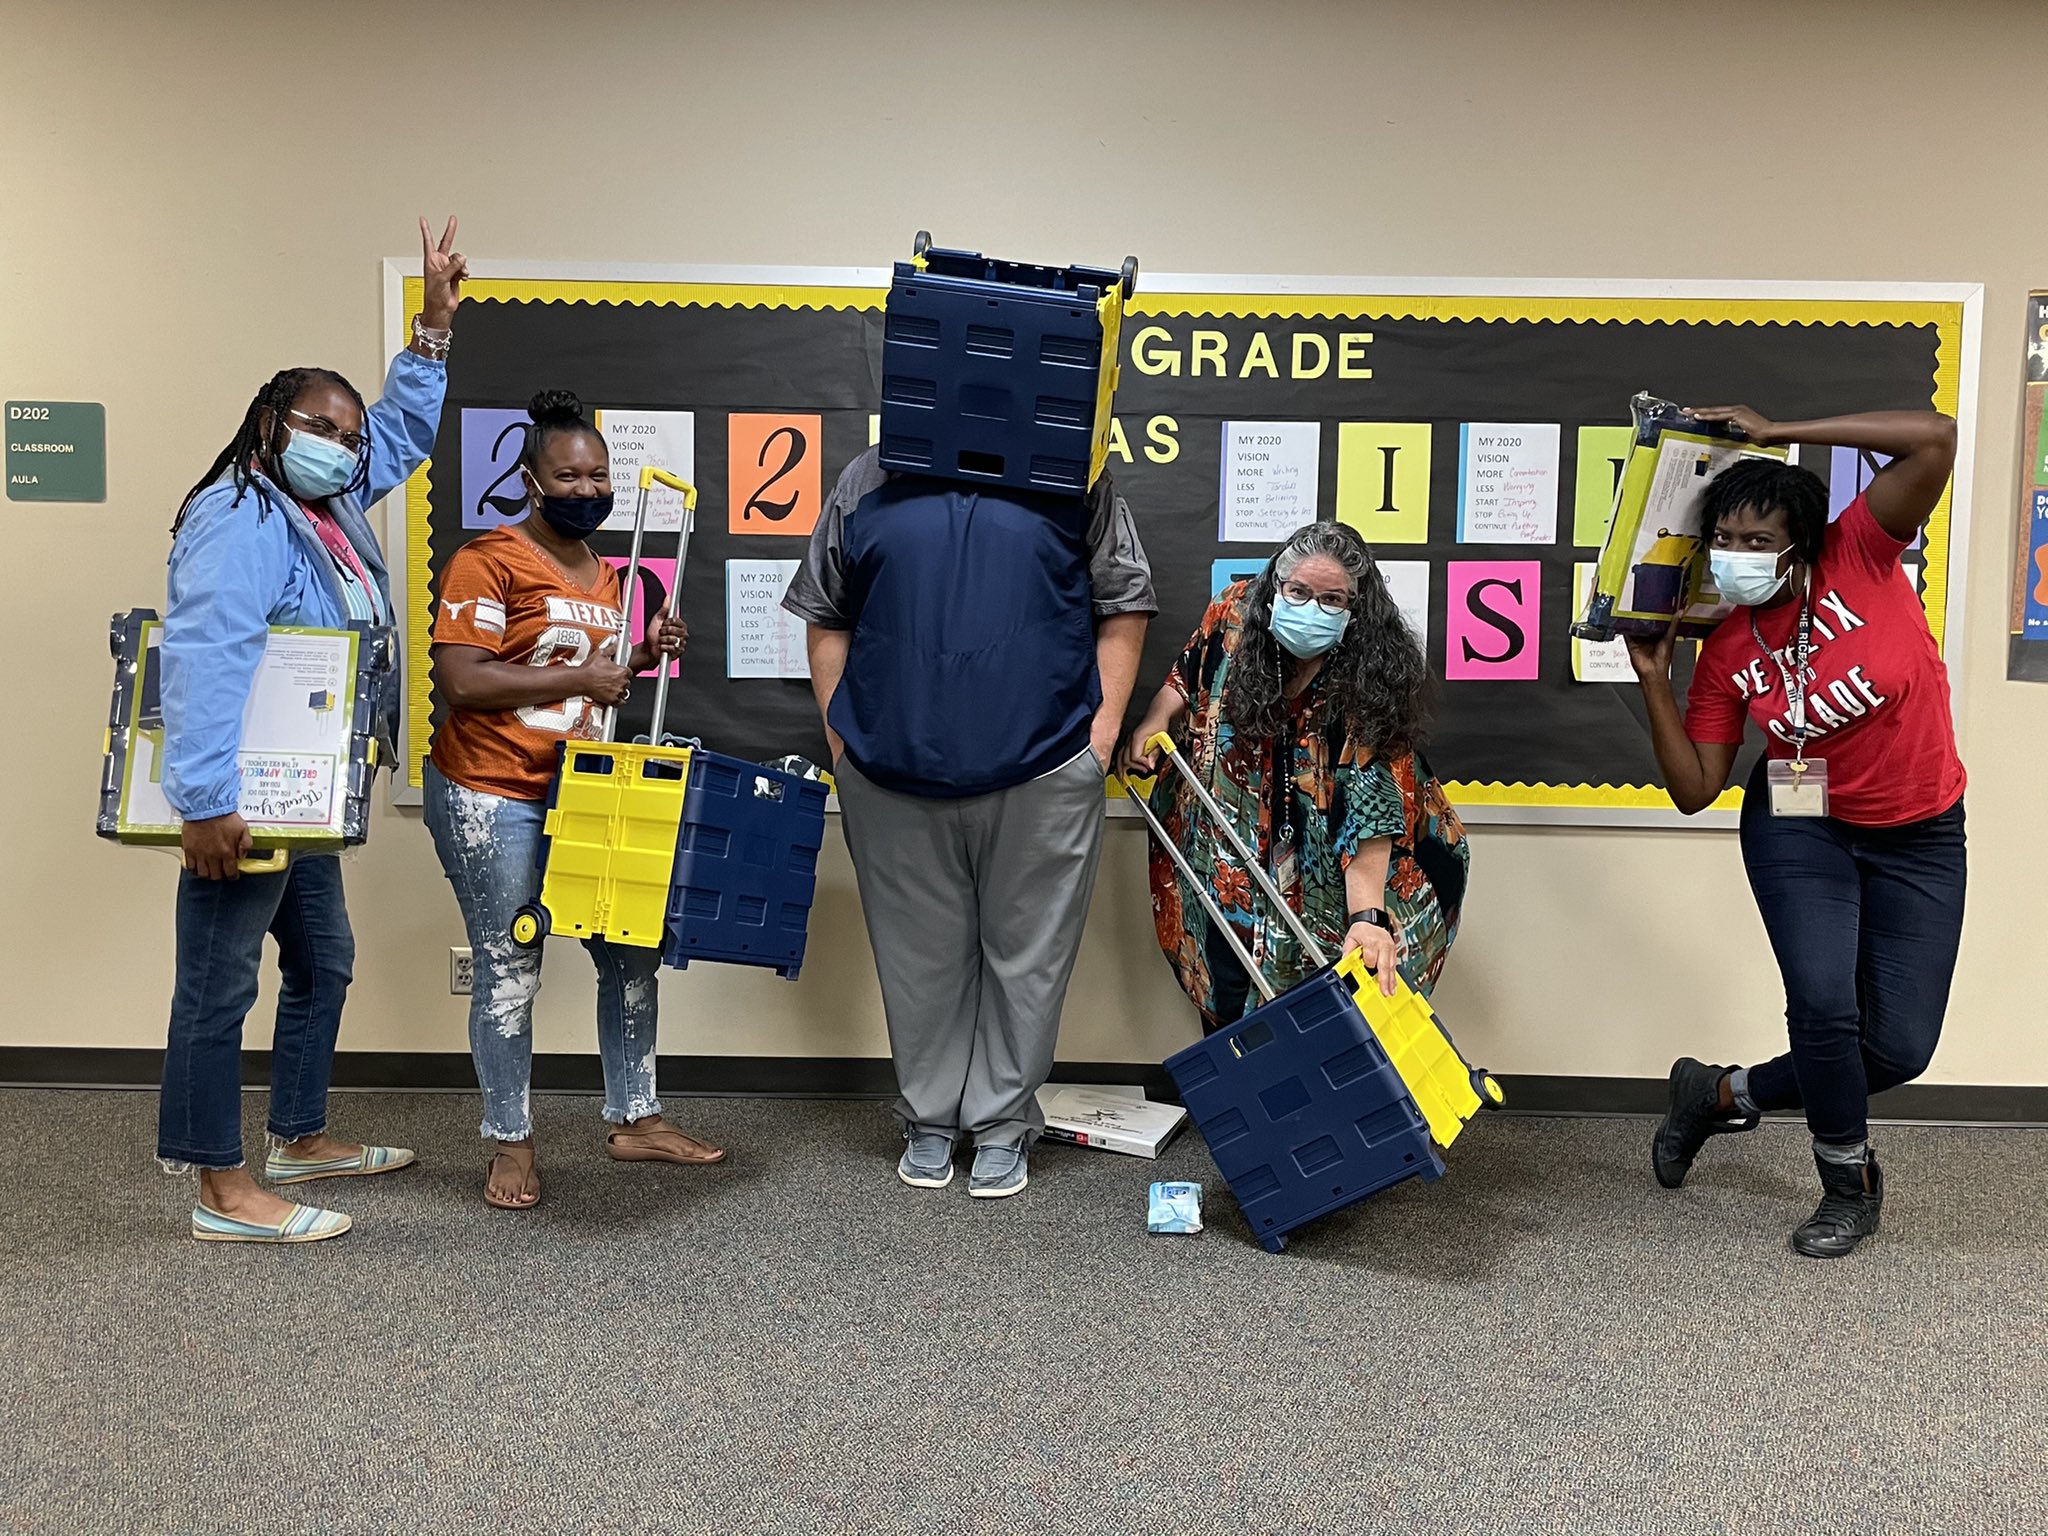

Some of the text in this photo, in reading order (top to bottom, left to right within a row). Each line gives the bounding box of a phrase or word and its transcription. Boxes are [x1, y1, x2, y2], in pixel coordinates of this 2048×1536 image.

[1131, 326, 1375, 380] GRADE
[10, 407, 50, 420] D202
[612, 425, 656, 434] MY 2020
[1238, 436, 1282, 445] MY 2020
[1478, 437, 1522, 447] MY 2020
[11, 443, 74, 453] CLASSROOM
[612, 442, 645, 450] VISION
[1237, 453, 1270, 461] VISION
[1477, 454, 1510, 463] VISION
[612, 458, 639, 466] MORE
[477, 421, 532, 517] 2
[1237, 468, 1264, 477] MORE
[612, 472, 631, 480] LESS
[743, 427, 807, 521] 2
[1476, 470, 1503, 478] MORE
[11, 475, 39, 484] AULA
[1375, 446, 1402, 513] I
[1237, 483, 1255, 491] LESS
[740, 574, 783, 583] MY 2020
[740, 590, 773, 599] VISION
[740, 606, 767, 614] MORE
[565, 601, 623, 629] TEXAS
[1800, 606, 1809, 628] THE
[741, 620, 759, 628] LESS
[1461, 578, 1525, 664] S
[557, 629, 581, 645] 1883
[283, 768, 318, 779] GREATLY
[242, 788, 323, 817] Thank You
